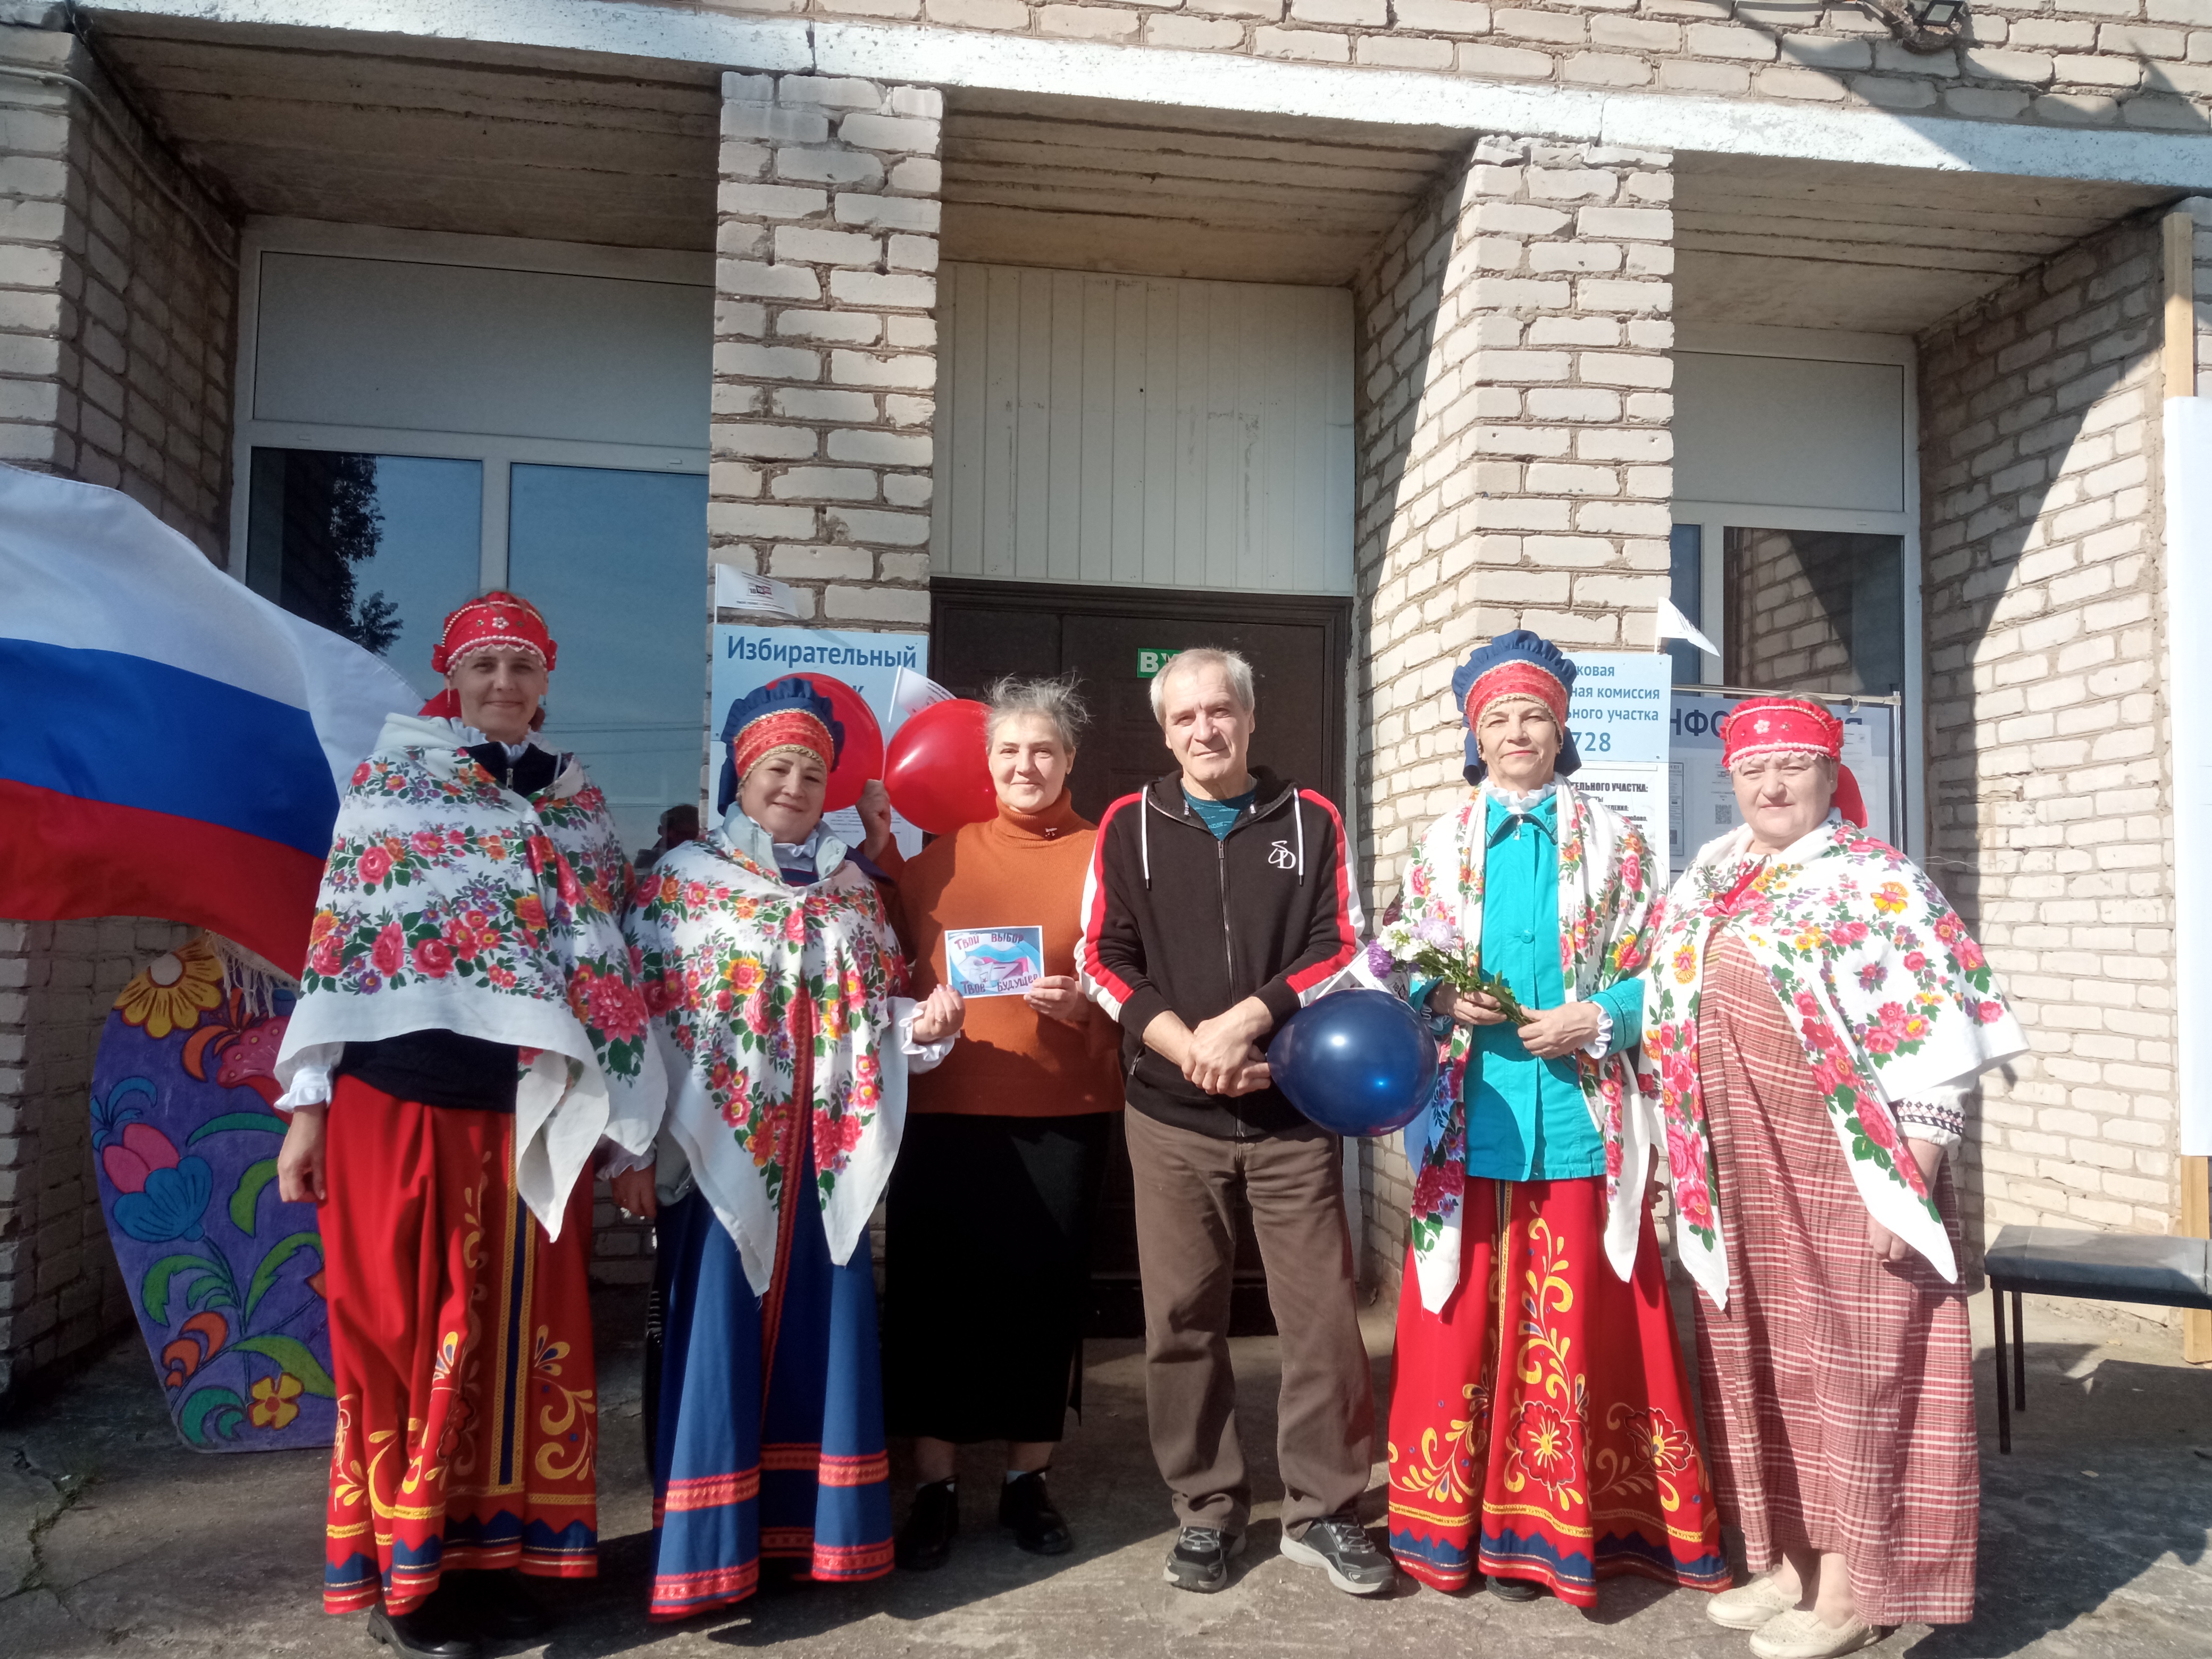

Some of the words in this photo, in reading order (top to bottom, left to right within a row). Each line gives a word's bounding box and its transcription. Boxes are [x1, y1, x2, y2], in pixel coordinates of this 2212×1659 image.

[728, 635, 916, 668] Избирательный
[1597, 688, 1660, 699] комиссия
[1607, 710, 1658, 723] участка
[1612, 783, 1648, 792] УЧАСТКА:
